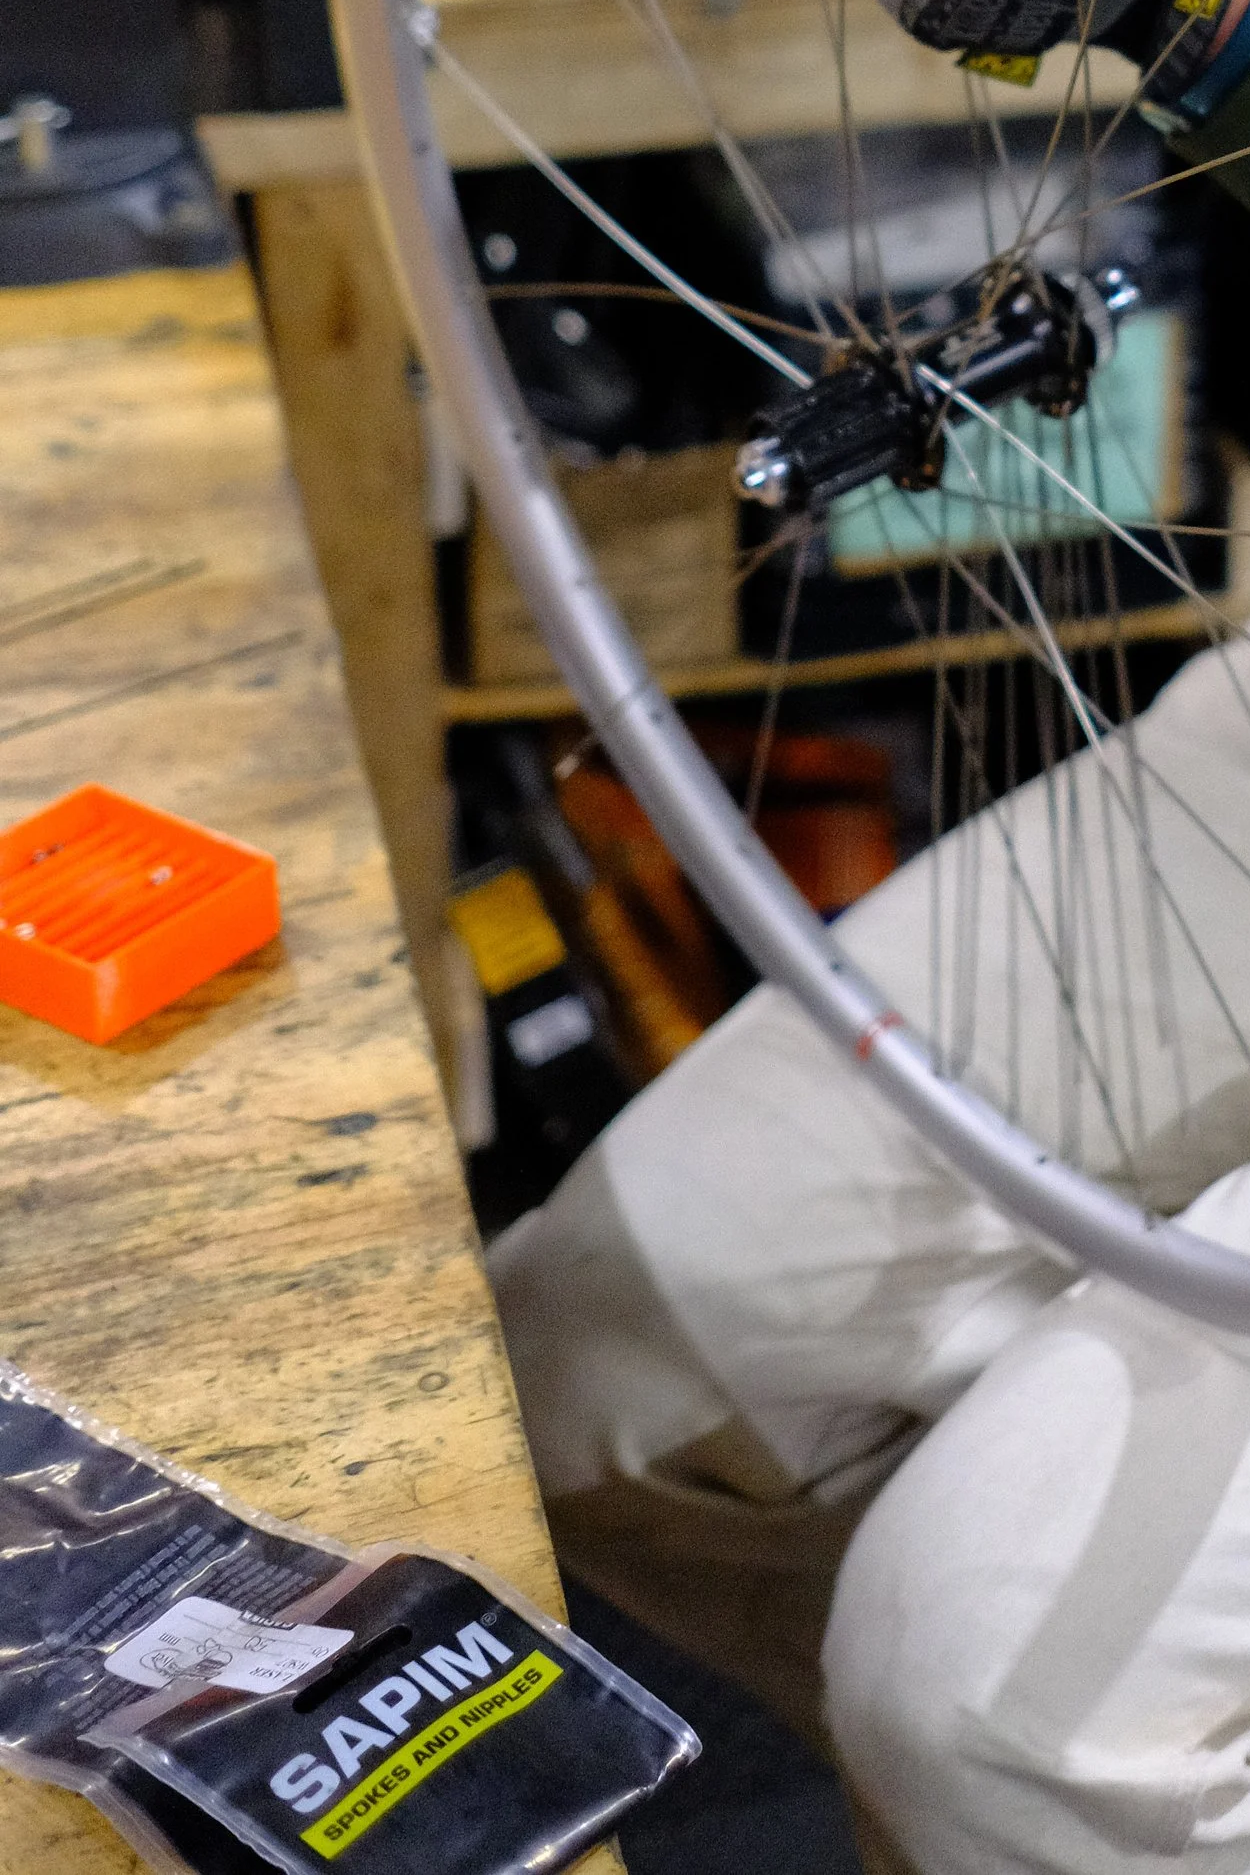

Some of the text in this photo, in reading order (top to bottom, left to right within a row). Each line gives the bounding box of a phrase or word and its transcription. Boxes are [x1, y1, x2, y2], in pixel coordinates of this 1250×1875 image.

[269, 1620, 514, 1813] SAPIM
[323, 1666, 544, 1842] SPOKES AND NIPPLES
